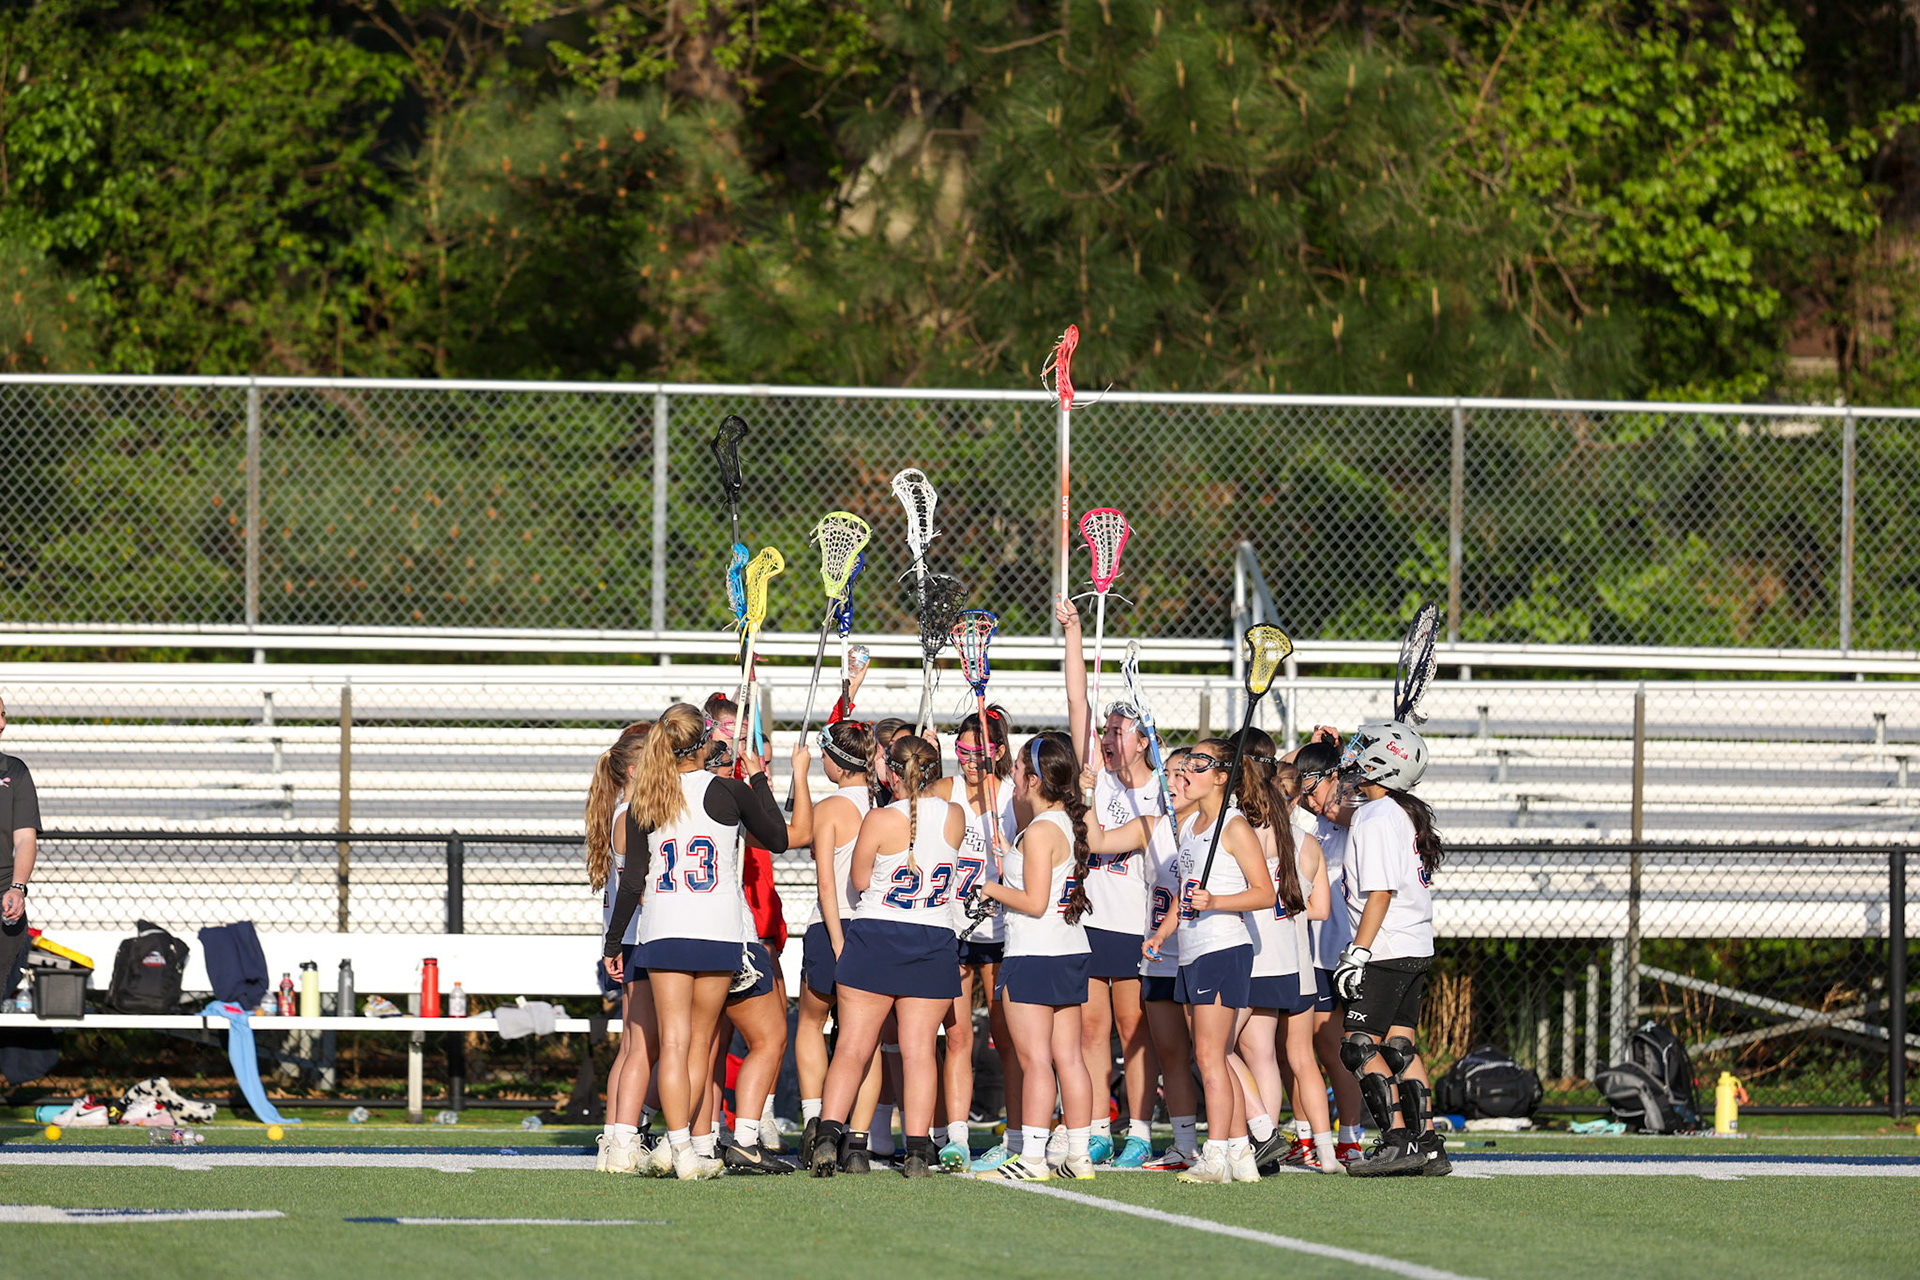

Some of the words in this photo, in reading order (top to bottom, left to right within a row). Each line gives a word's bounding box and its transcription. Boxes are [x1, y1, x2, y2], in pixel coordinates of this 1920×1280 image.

[656, 835, 719, 894] 13
[881, 863, 954, 910] 22
[1346, 1010, 1368, 1023] STX
[1406, 1141, 1419, 1155] N
